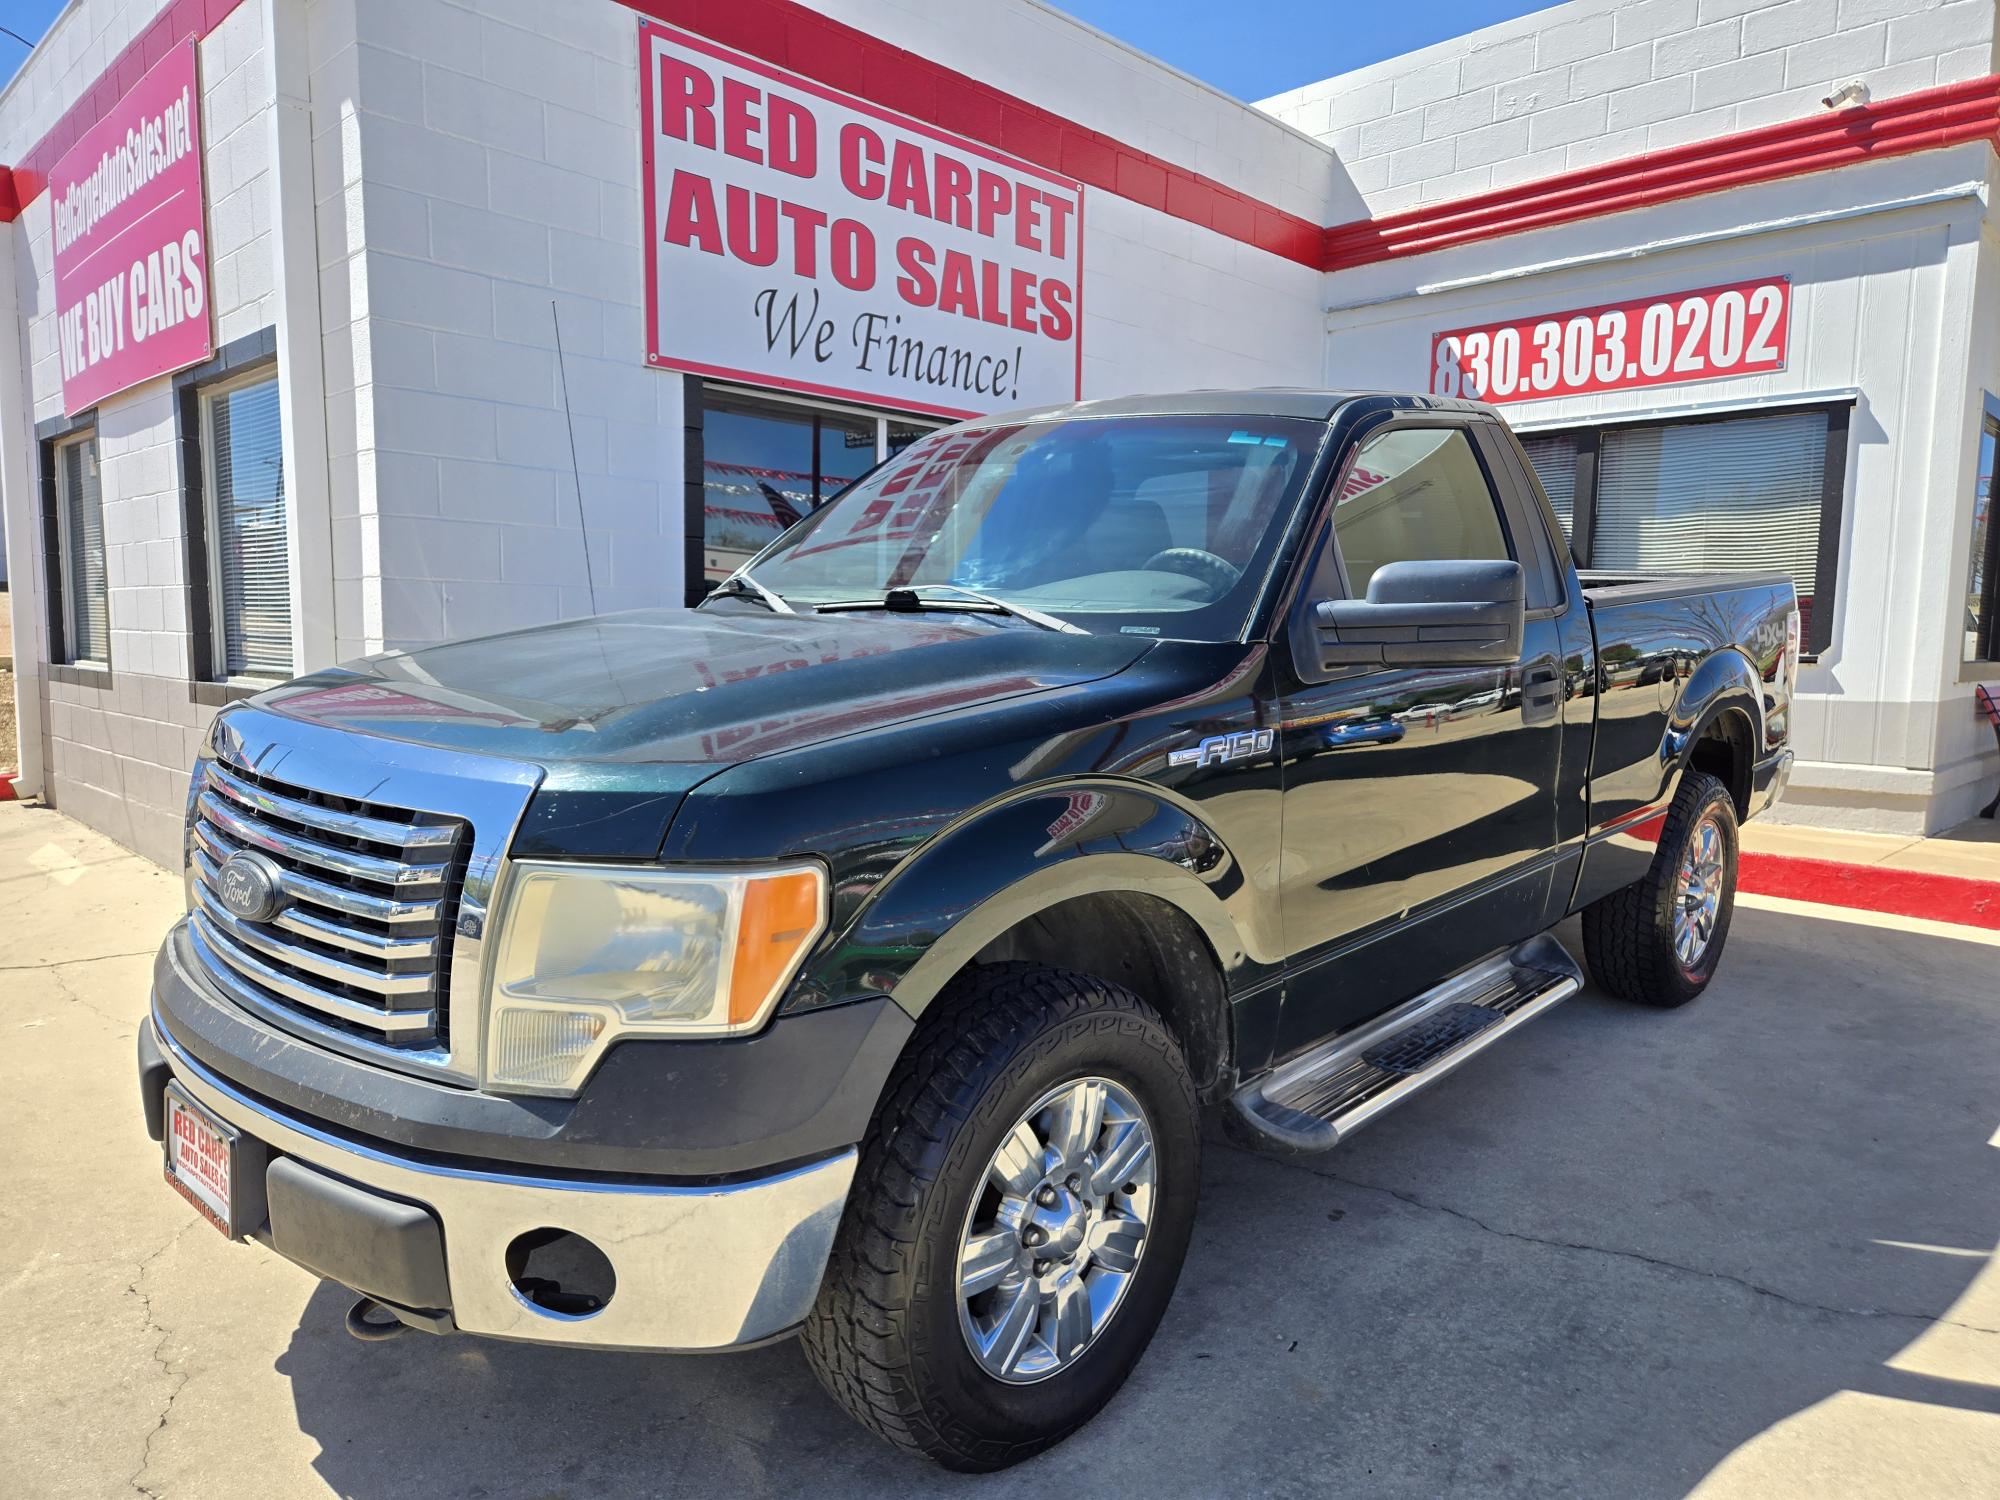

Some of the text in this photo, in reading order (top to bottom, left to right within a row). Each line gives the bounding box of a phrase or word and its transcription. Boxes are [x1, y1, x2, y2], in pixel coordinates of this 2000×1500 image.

[54, 84, 192, 256] RedCarpetAutoSales.net
[660, 53, 1074, 260] RED CARPET
[59, 229, 203, 382] WE BUY CARS
[664, 168, 1073, 341] AUTO SALES
[754, 288, 1022, 400] We Finance!
[1434, 285, 1783, 400] 830.303.0202
[223, 870, 252, 907] Ford
[174, 1109, 196, 1146] RED
[197, 1125, 229, 1175] CARPE
[181, 1142, 199, 1169] AUTO
[200, 1156, 219, 1187] SALES
